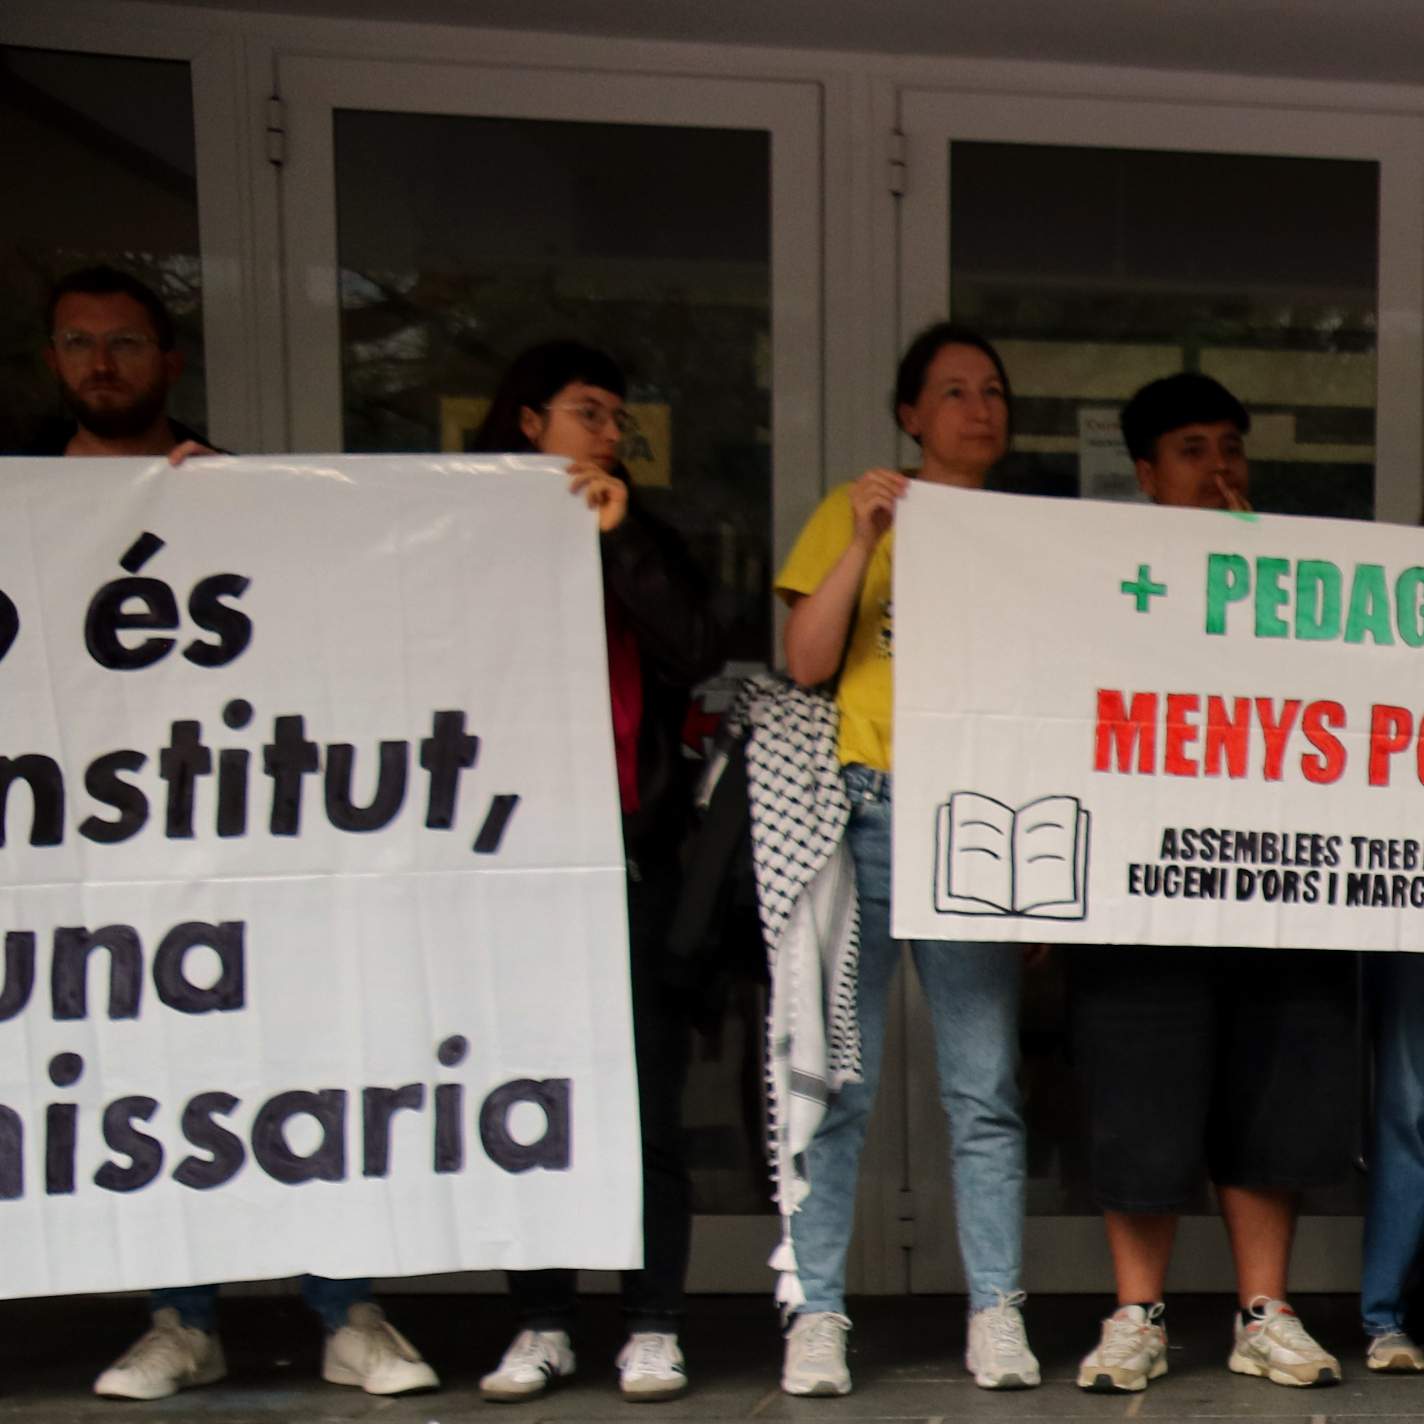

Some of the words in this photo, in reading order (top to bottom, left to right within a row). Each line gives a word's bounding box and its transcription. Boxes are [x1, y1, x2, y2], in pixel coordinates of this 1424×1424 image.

[83, 531, 253, 672] és
[1093, 688, 1348, 785] MENYS
[1160, 827, 1342, 868] ASSEMBLEES
[1127, 863, 1229, 900] EUGENI
[1236, 867, 1320, 906] D'ORS
[1327, 872, 1338, 906] I
